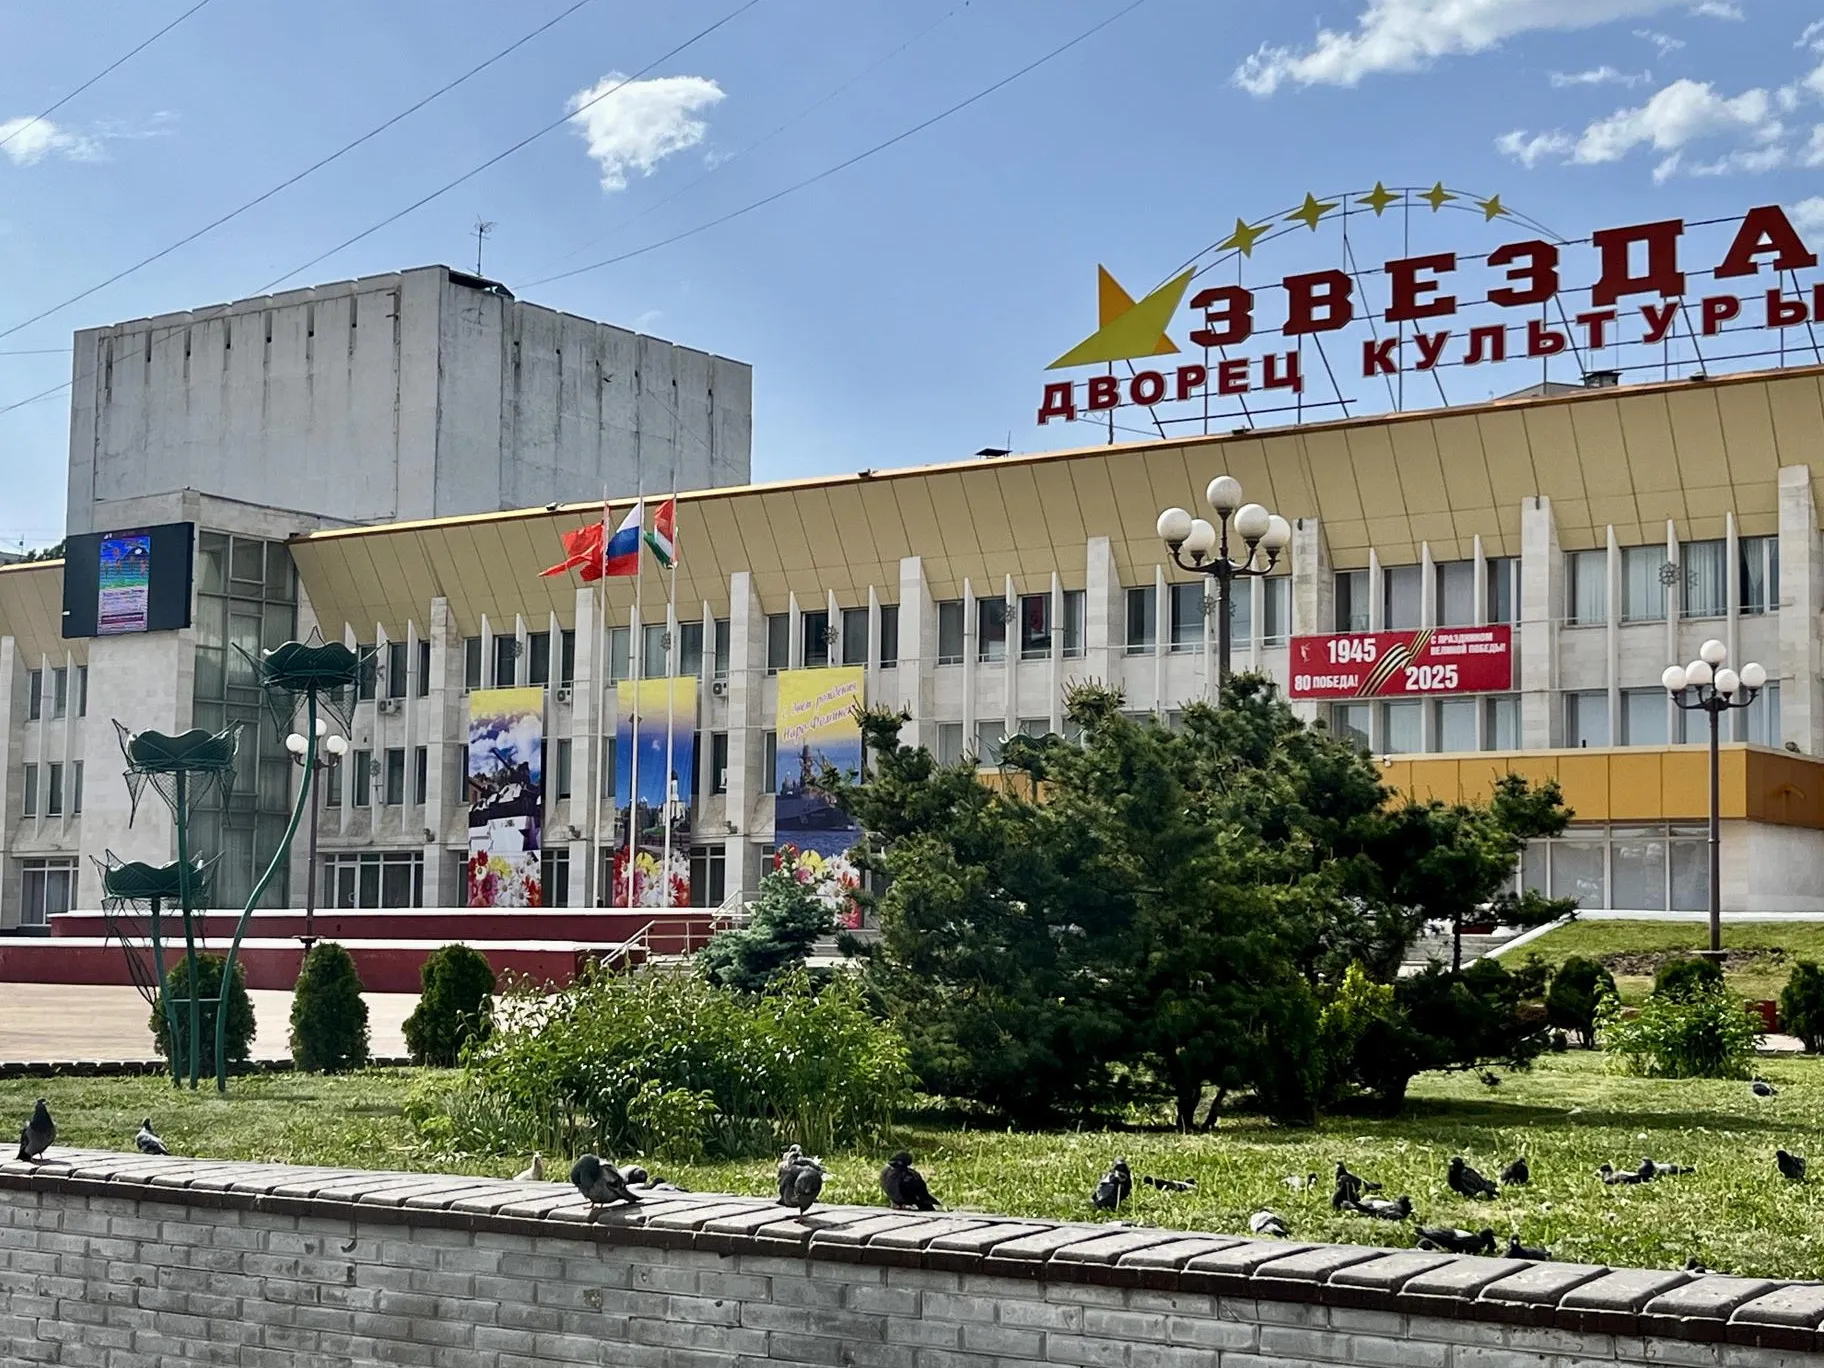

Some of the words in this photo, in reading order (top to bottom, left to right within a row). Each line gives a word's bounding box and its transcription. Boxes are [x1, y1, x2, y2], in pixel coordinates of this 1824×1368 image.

[1190, 204, 1818, 347] ЗВЕЗДА
[1037, 350, 1304, 425] ДВОРЕЦ
[1362, 283, 1824, 377] КУЛЬТУРЫ
[1327, 638, 1377, 664] 1945
[1294, 674, 1311, 691] 80
[1312, 674, 1359, 690] ПОБЕДА!
[1405, 664, 1459, 690] 2025
